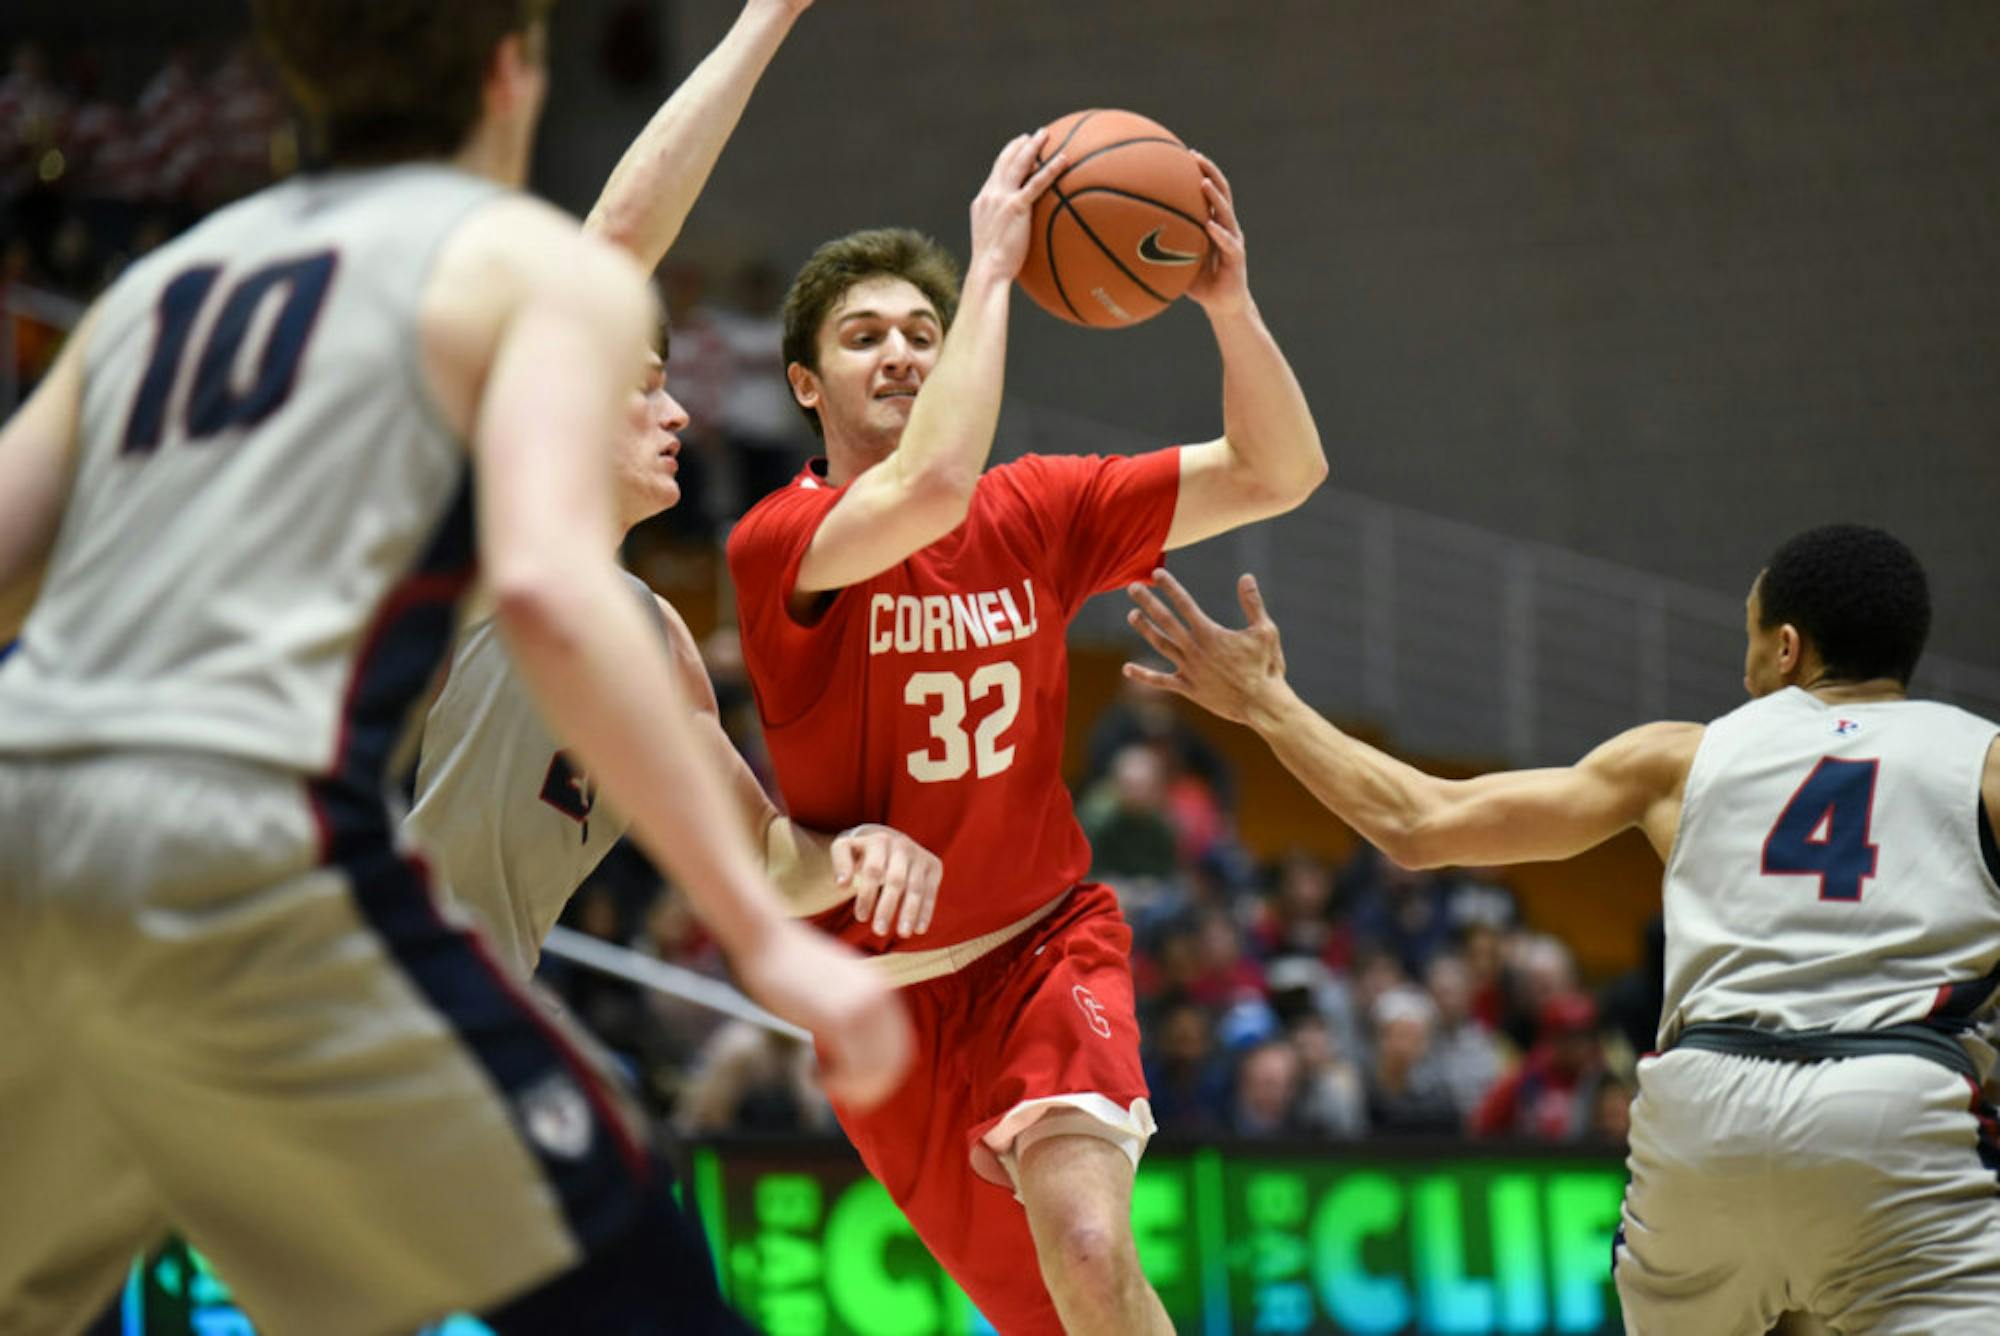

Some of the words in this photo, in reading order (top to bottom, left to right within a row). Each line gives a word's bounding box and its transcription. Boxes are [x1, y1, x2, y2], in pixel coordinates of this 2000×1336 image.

[117, 246, 339, 457] 10
[904, 660, 1022, 783] 32
[1760, 755, 1880, 903] 4
[1312, 1171, 1624, 1335] CLIF
